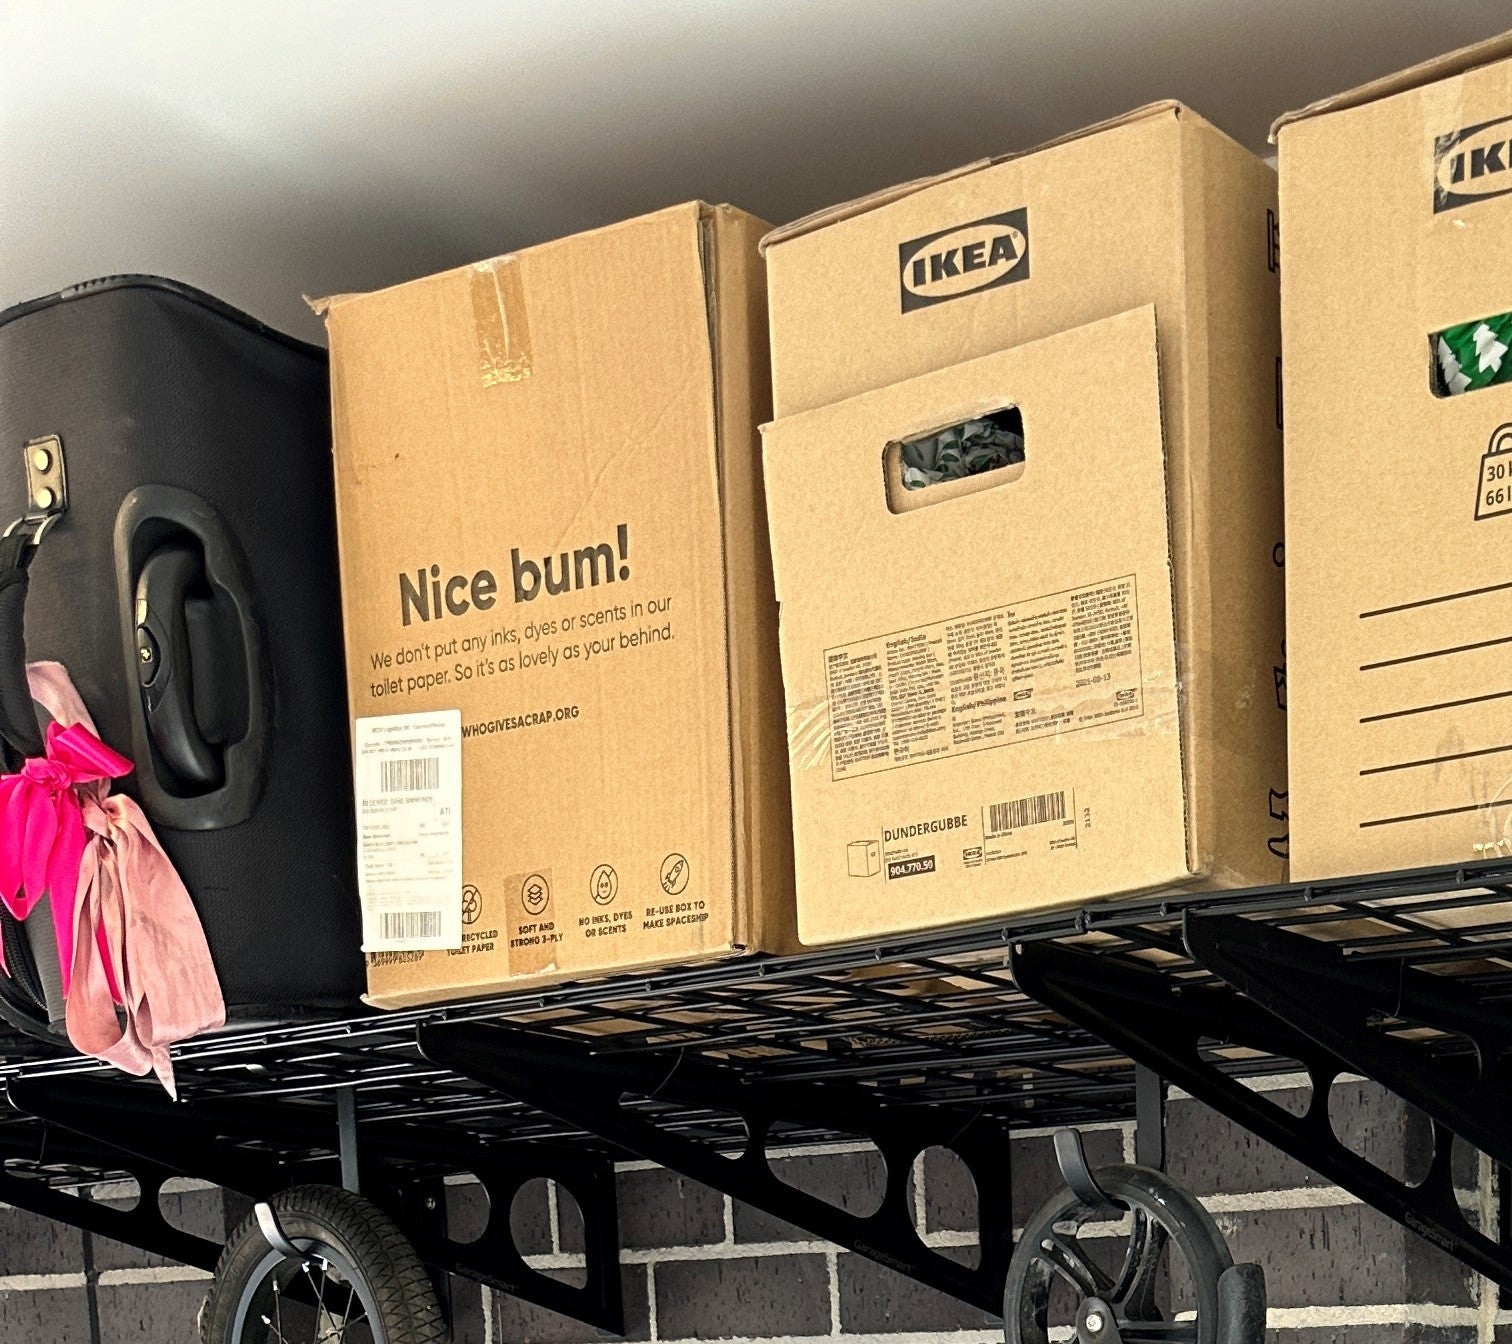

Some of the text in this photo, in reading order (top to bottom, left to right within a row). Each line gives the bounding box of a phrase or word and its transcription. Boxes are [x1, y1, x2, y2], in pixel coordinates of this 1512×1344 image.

[912, 233, 1020, 288] IKEA
[1486, 463, 1506, 483] 30
[1485, 486, 1506, 508] 66
[399, 523, 631, 627] Nice bum!
[370, 596, 673, 671] We don't put any inks, dyes or scents in our
[370, 621, 676, 698] toilet paper. So it's as lovely as your behind.
[461, 705, 580, 739] WHOGIVESACRAP.ORG
[1084, 807, 1092, 828] 2132
[884, 814, 968, 843] DUNDERGUBBE
[890, 859, 934, 877] 904.770.50
[646, 900, 706, 917] RE-USE BOX TO
[518, 921, 555, 935] SOFT AND
[578, 915, 590, 927] NO
[613, 911, 633, 923] DYES
[643, 912, 709, 930] MAKE SPACESHIP
[510, 932, 564, 948] STRONG 3-PLY
[585, 924, 627, 938] OR SCENTS
[471, 942, 494, 954] PAPER
